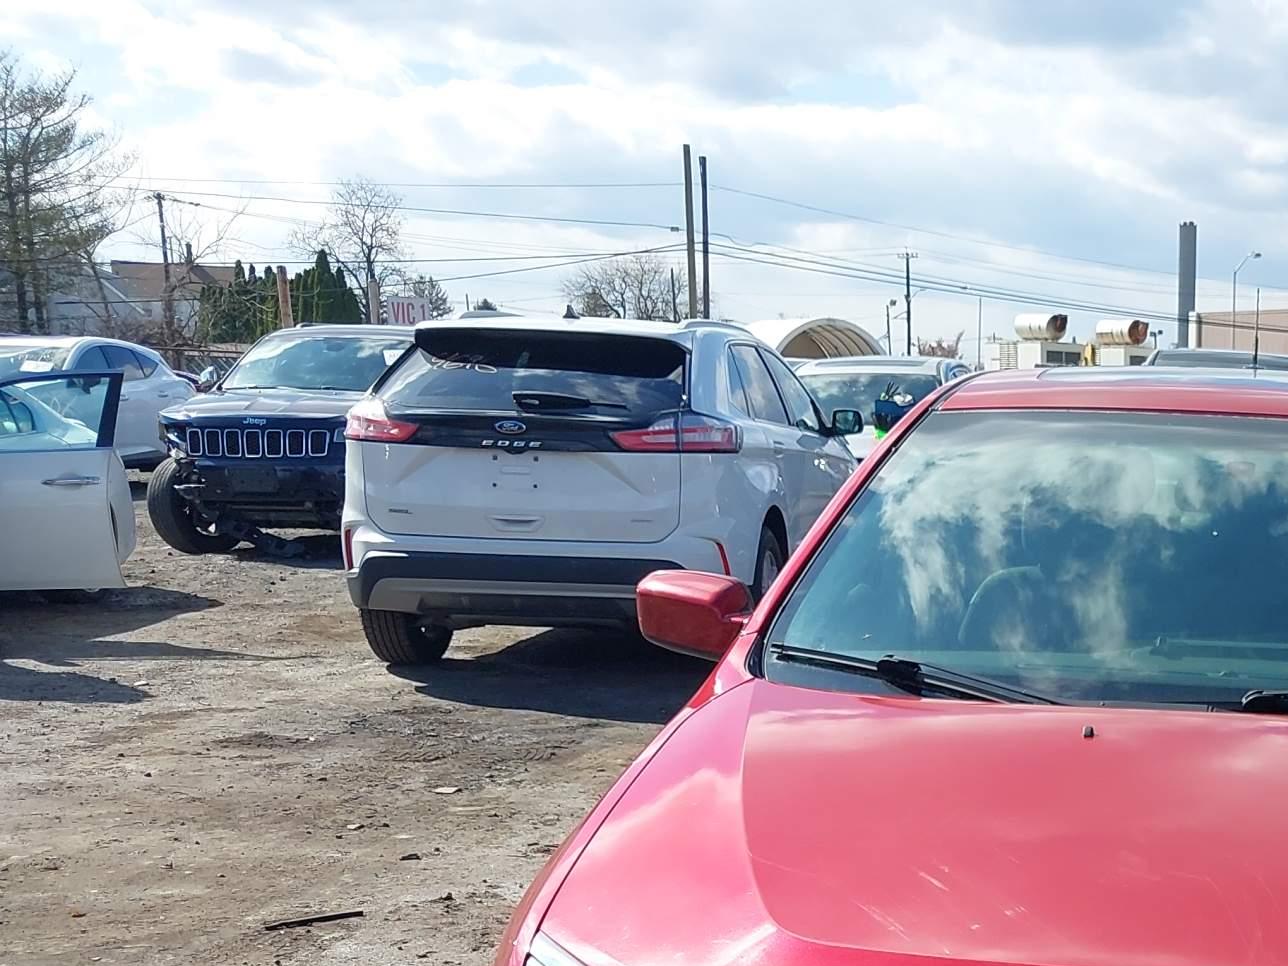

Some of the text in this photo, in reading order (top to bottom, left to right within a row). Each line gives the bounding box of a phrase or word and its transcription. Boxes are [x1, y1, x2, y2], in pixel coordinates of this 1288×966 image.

[391, 301, 426, 325] VIC 1
[242, 417, 267, 426] Jeep
[481, 439, 542, 448] EDGE
